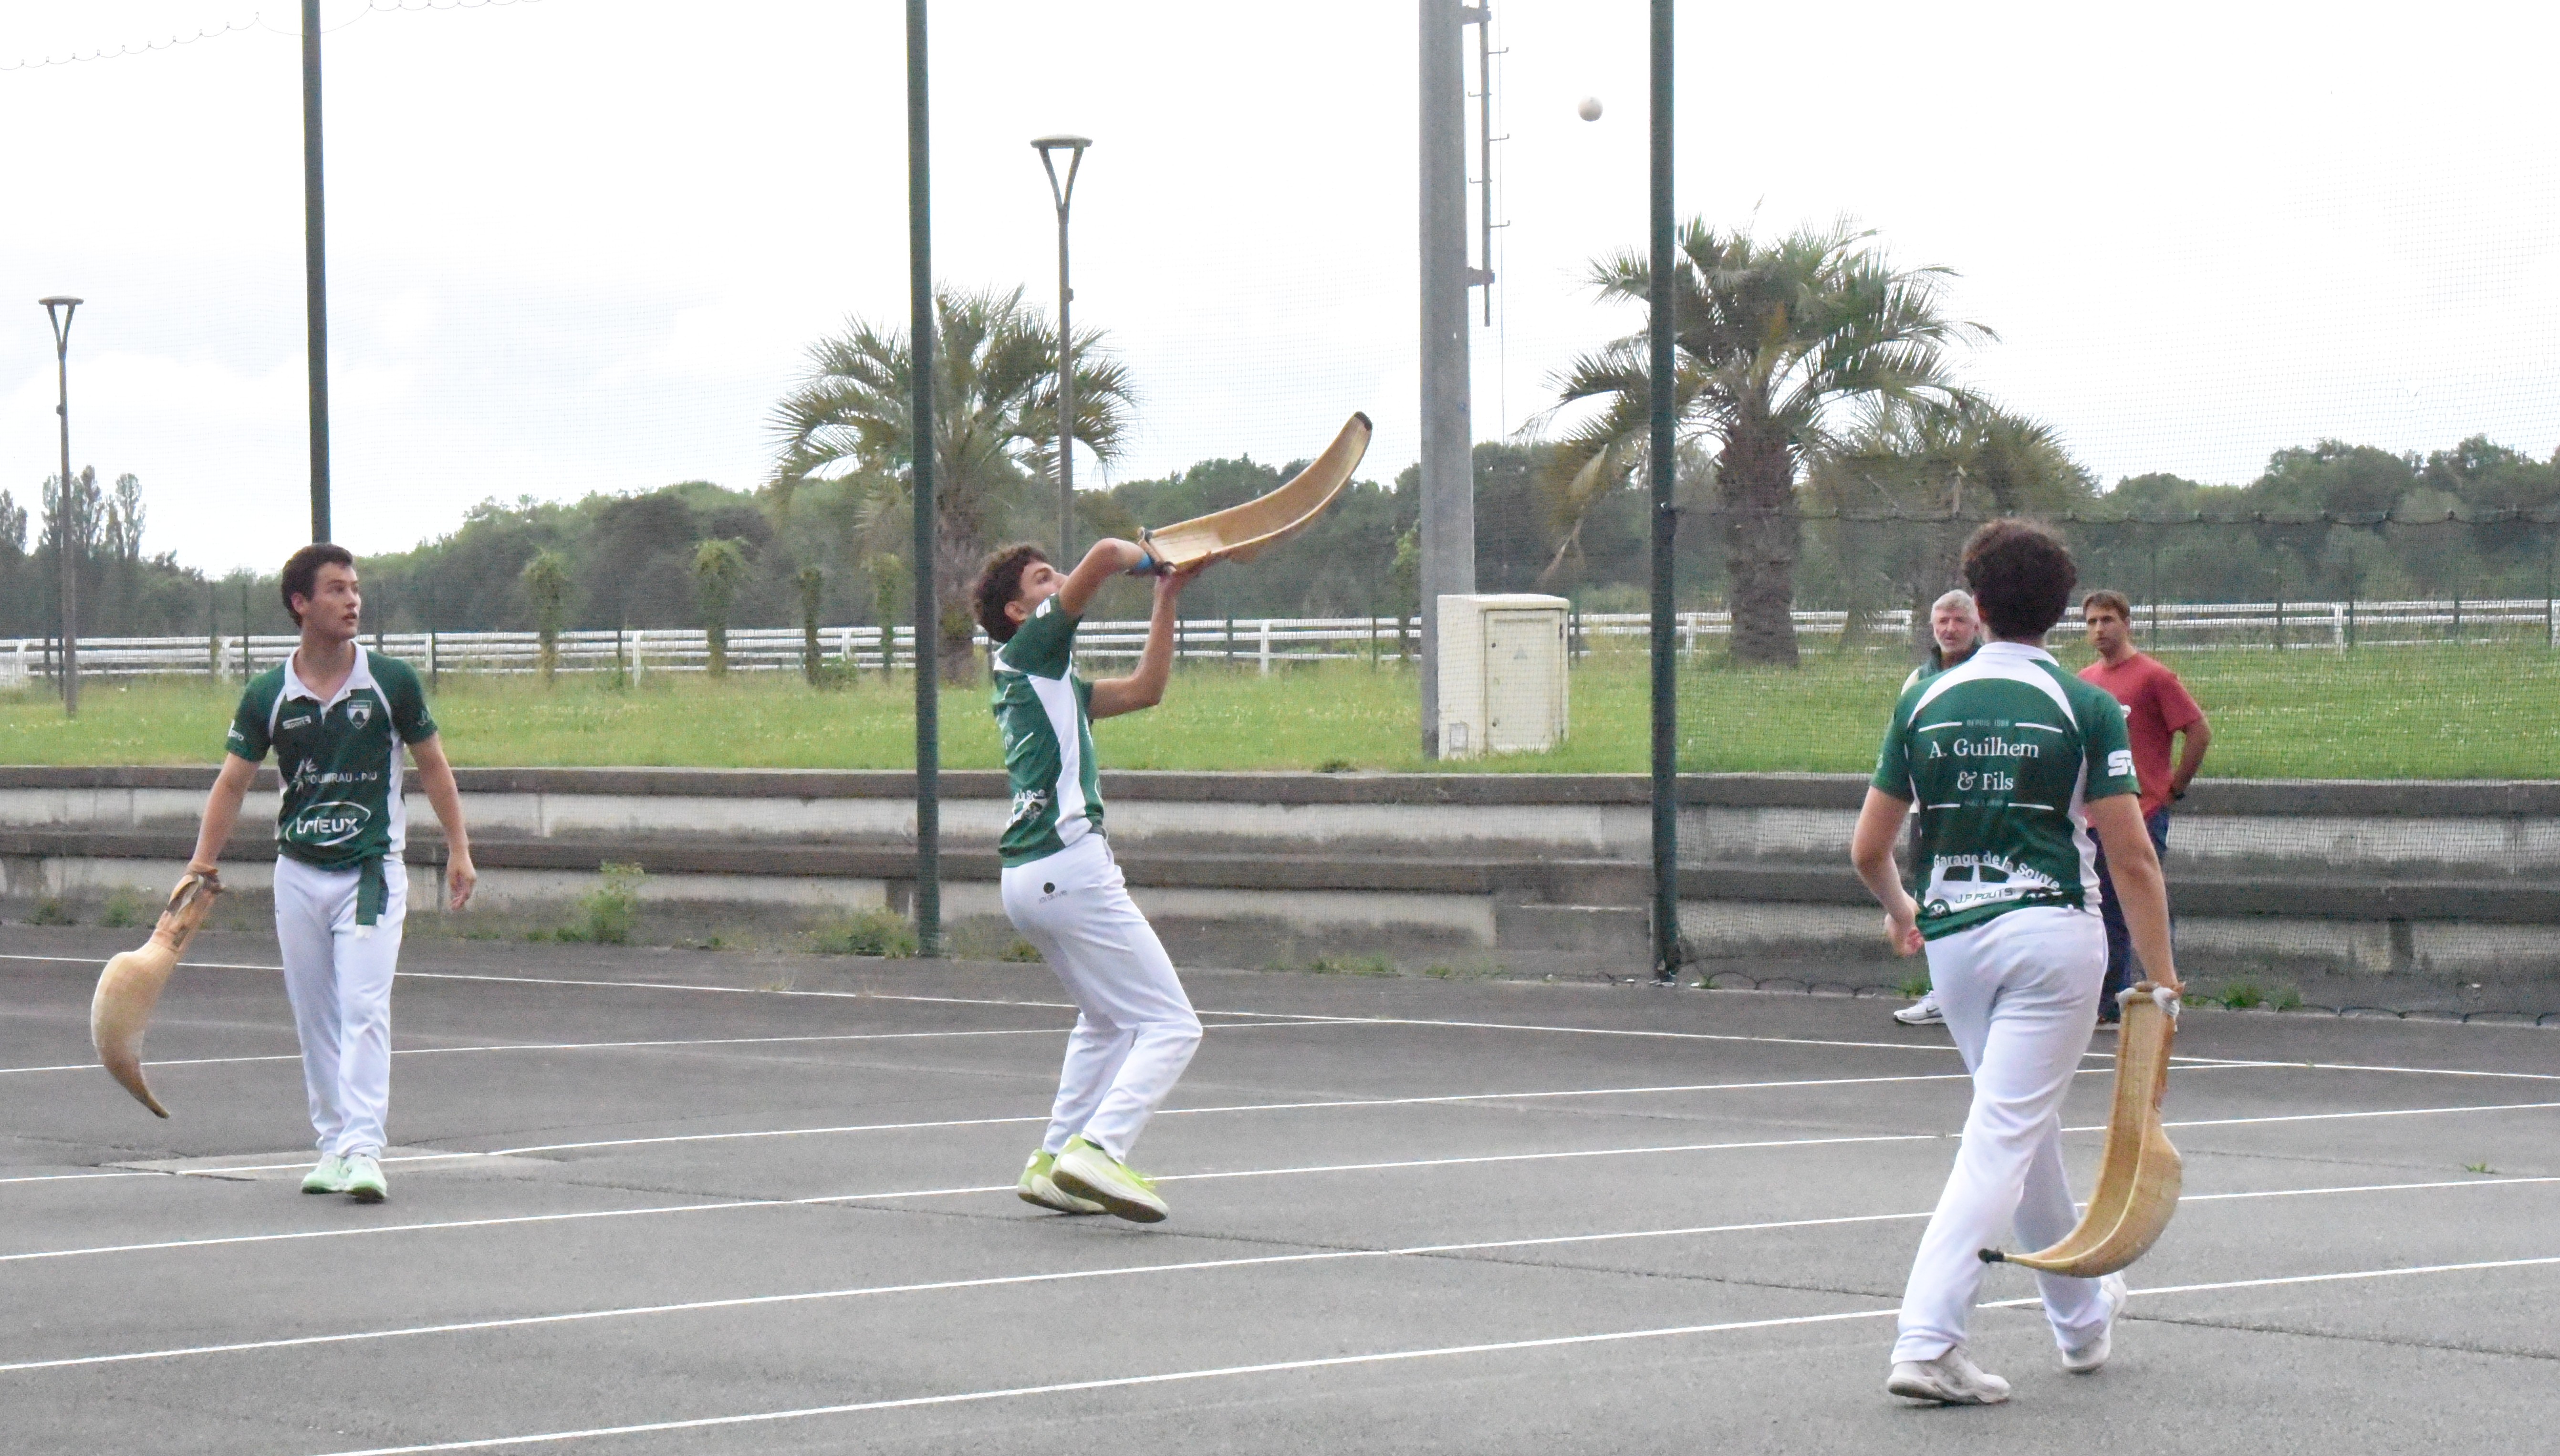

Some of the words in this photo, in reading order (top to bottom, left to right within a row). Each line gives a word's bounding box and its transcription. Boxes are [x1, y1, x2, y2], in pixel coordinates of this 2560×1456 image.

[1929, 741, 1947, 759] A.
[1953, 737, 2039, 758] Guilhem
[1957, 771, 1977, 790] &
[1982, 771, 2014, 790] Fils
[1934, 854, 1979, 867] Garage
[1983, 851, 1999, 865] de
[2001, 856, 2014, 873] la
